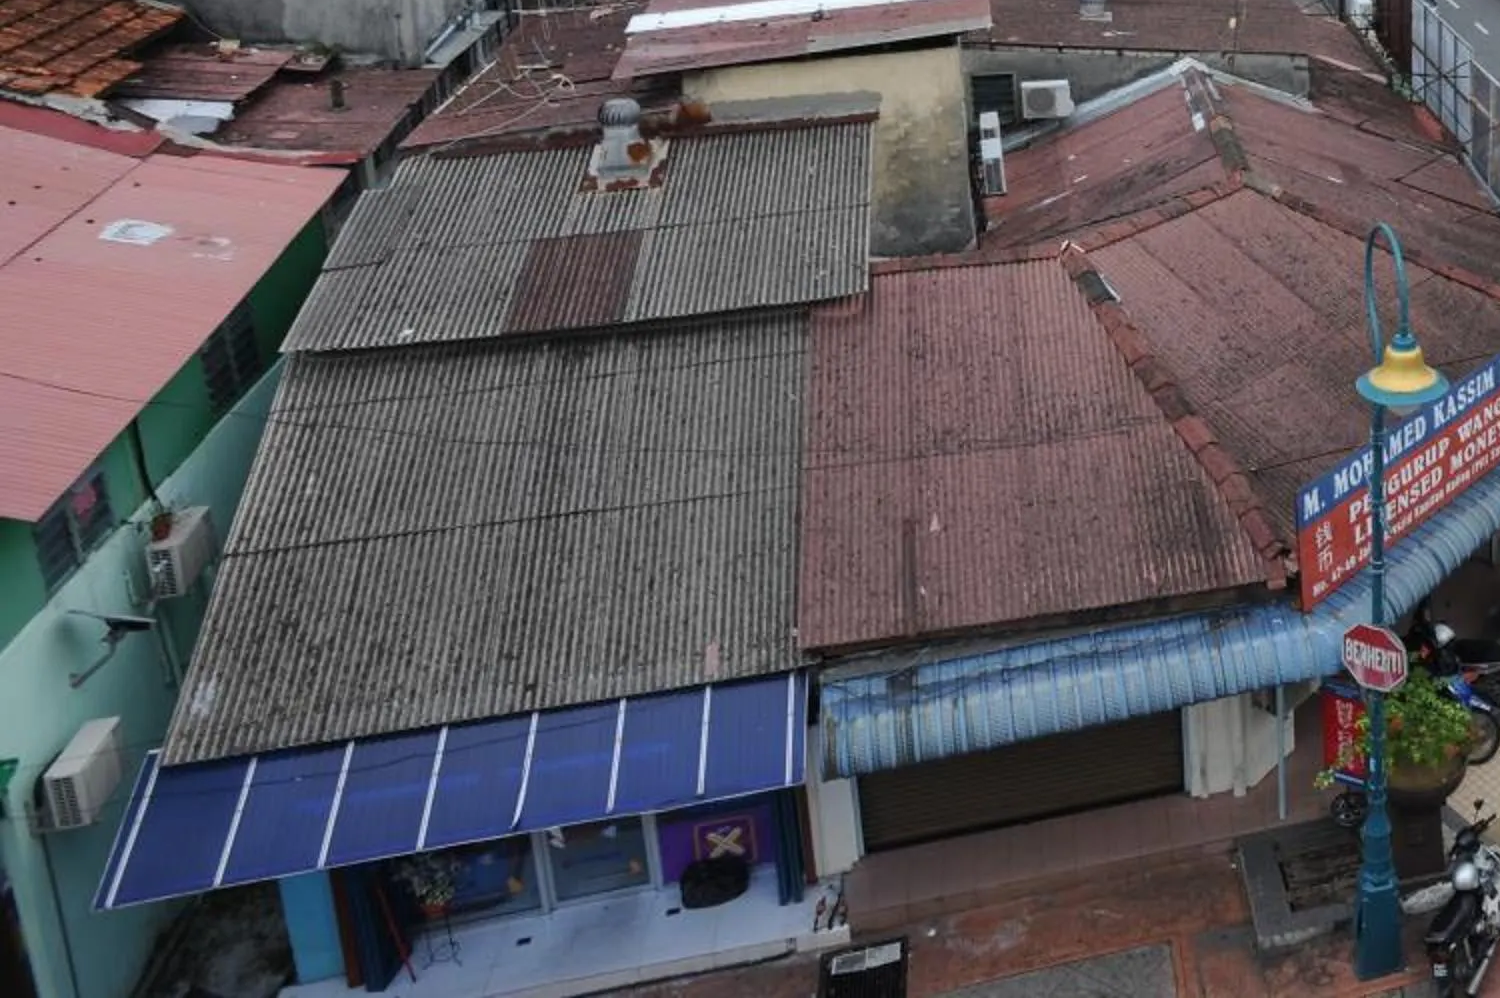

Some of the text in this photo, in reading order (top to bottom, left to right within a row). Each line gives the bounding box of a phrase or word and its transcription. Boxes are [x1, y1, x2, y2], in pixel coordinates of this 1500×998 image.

[1303, 488, 1326, 521] M.
[1433, 365, 1495, 429] KASSIM
[1355, 466, 1443, 545] LIENSED
[1345, 637, 1403, 676] BERHENTI
